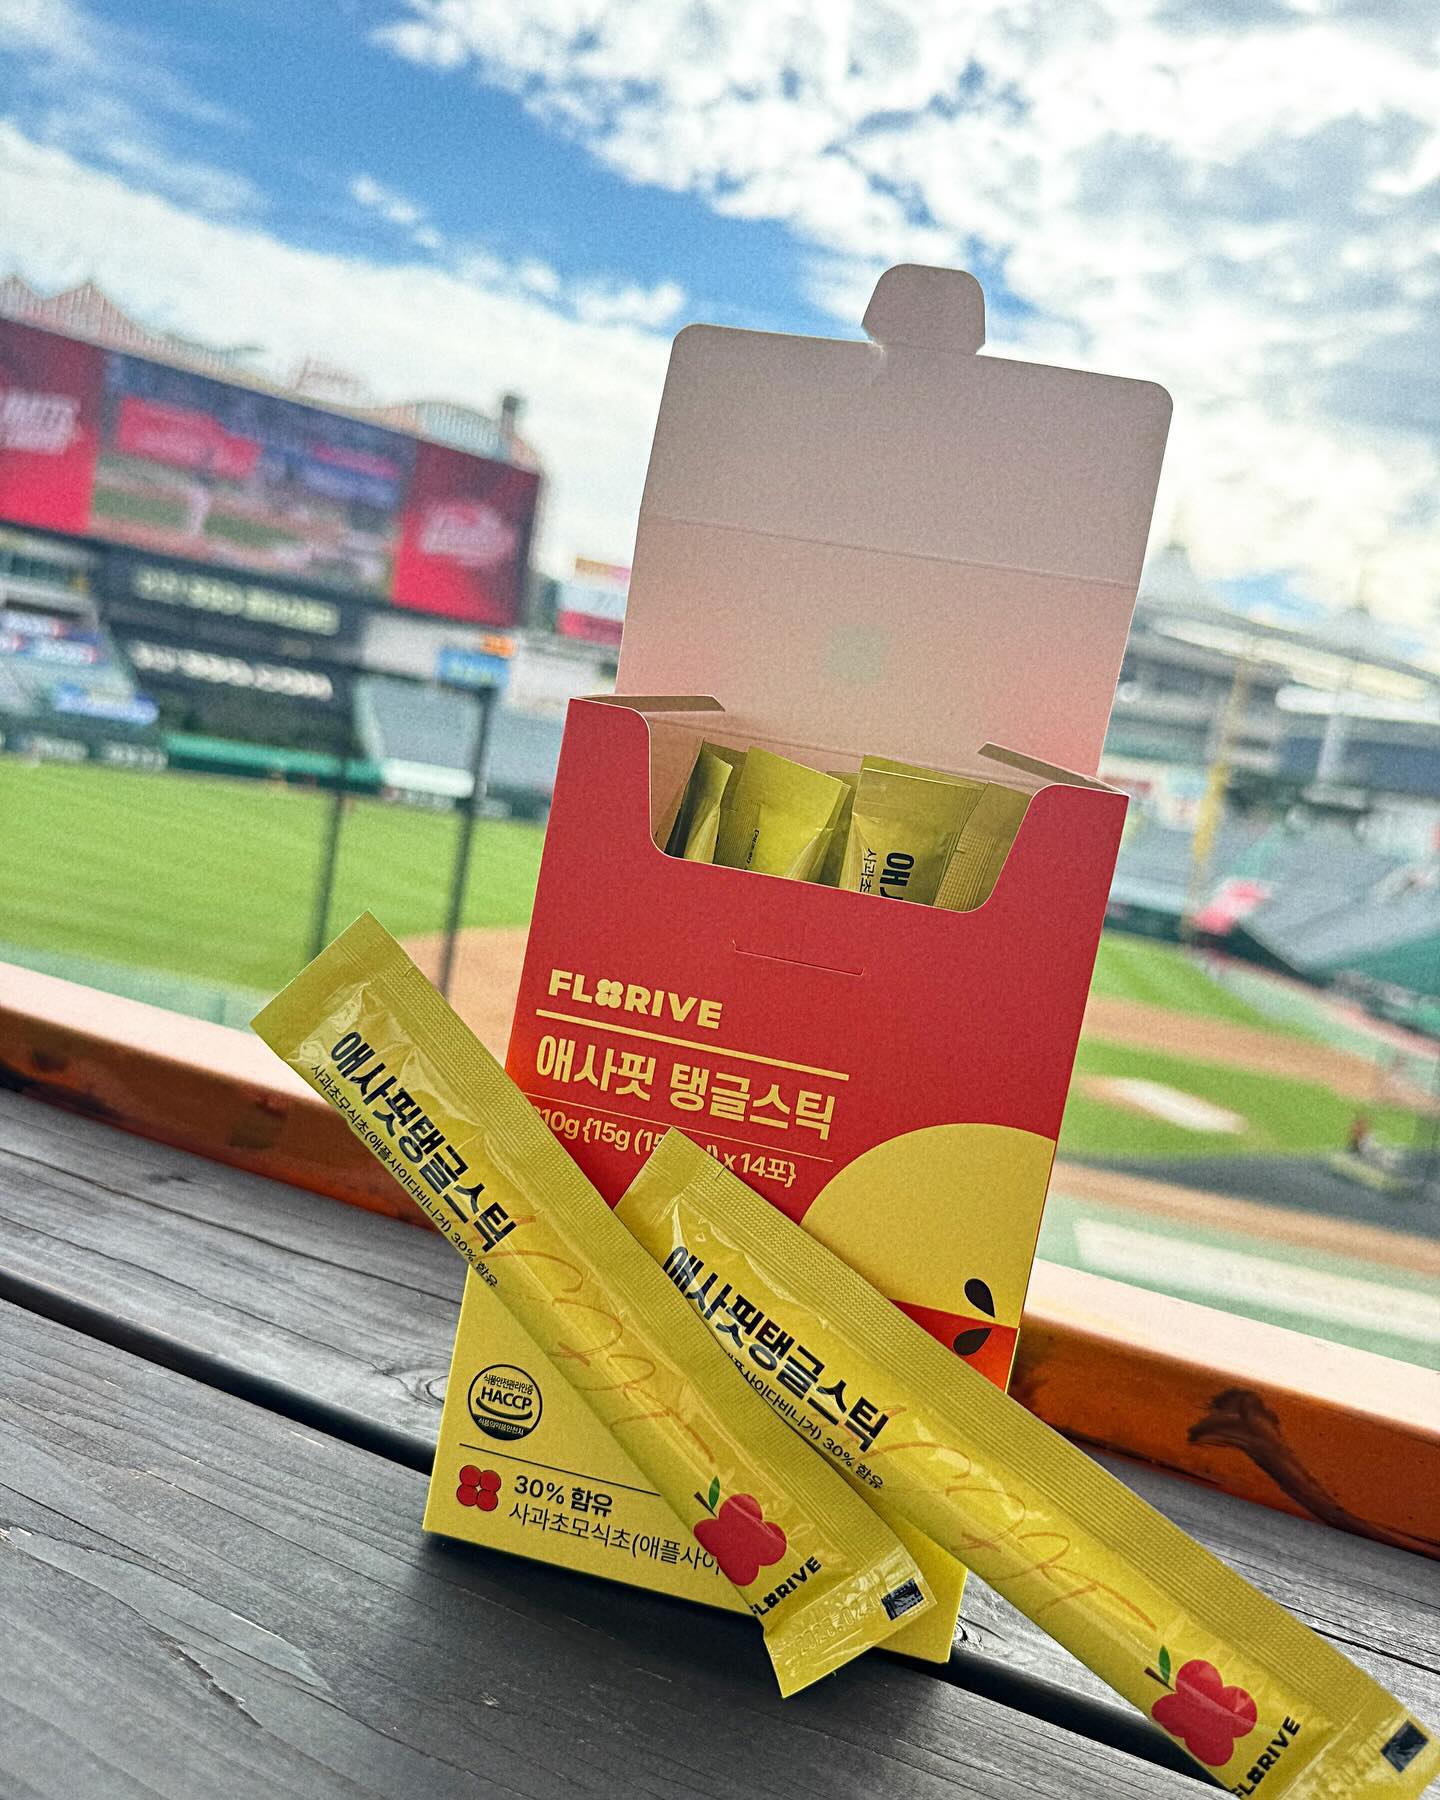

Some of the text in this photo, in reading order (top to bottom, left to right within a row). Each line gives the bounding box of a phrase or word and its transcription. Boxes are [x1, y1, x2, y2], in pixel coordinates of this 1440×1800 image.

[548, 969, 723, 1029] FLORIVE
[536, 1035, 836, 1141] 애사핏 탱글스틱
[311, 1063, 499, 1287] 사과초모식초(애플사이다비니거) 30% 함유
[331, 1031, 517, 1253] 애사핏탱글스틱
[534, 1106, 580, 1140] 10g
[741, 1153, 796, 1188] 14포}
[662, 1246, 889, 1453] 애사핏탱글스틱
[480, 1386, 533, 1410] HACCP
[514, 1475, 613, 1518] 30% 함유
[822, 1437, 855, 1466] 30%
[855, 1462, 884, 1489] 함유
